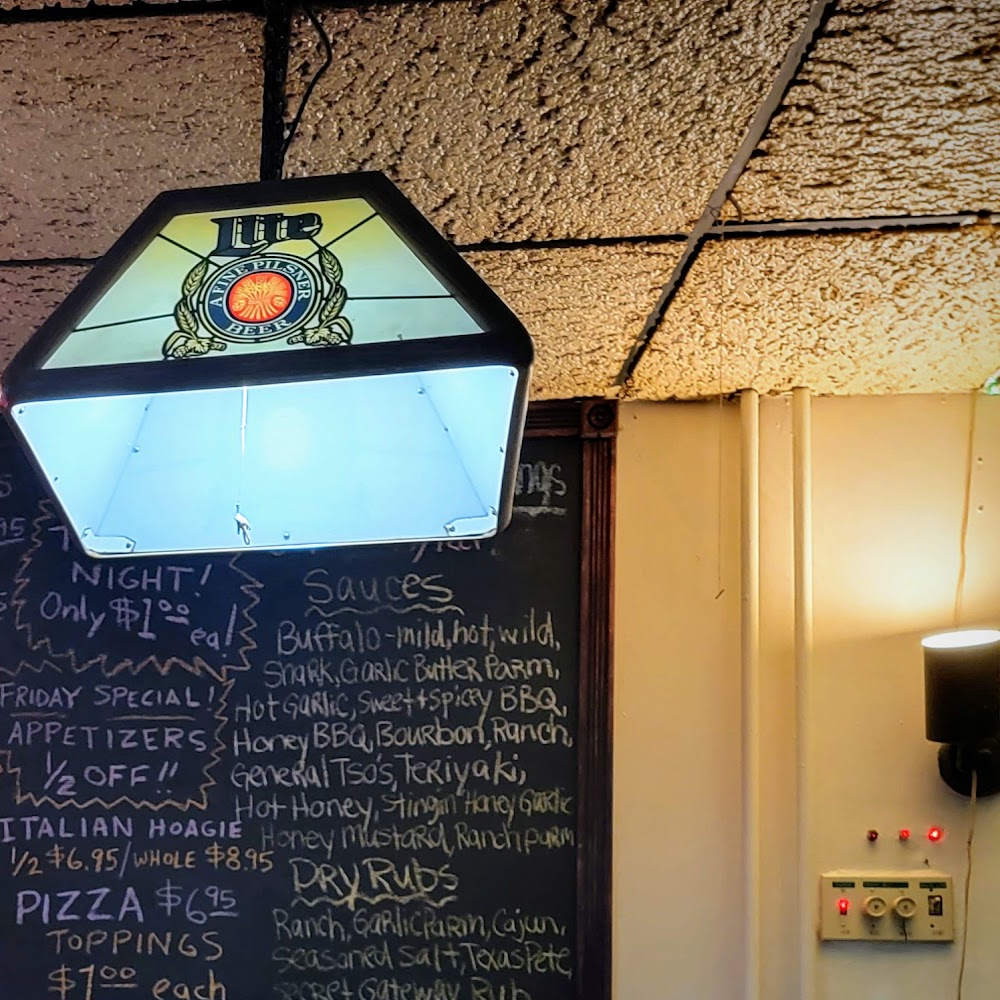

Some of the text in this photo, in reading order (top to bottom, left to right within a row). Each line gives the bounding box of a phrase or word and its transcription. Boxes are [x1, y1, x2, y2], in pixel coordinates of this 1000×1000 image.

[208, 212, 323, 257] Lite
[209, 261, 310, 307] A FINE PILSNER
[225, 319, 292, 336] BEER
[72, 561, 212, 597] NIGHT!
[303, 568, 453, 604] Sauces
[40, 592, 105, 638] Only
[190, 603, 237, 658] ea!
[94, 686, 215, 711] SPECIAL!
[235, 693, 279, 723] Hot
[8, 721, 207, 752] APPETIZERS
[234, 728, 308, 771] Honey
[235, 793, 286, 822] Hot
[0, 816, 243, 842] ITALIAN HOAGIE
[261, 825, 333, 859] Honey
[455, 822, 522, 850] Ranch
[205, 842, 274, 873] $8.95
[362, 857, 459, 894] Rubs
[16, 887, 143, 925] PIZZA
[47, 928, 223, 961] TOPPINGS
[459, 942, 524, 972] Texas
